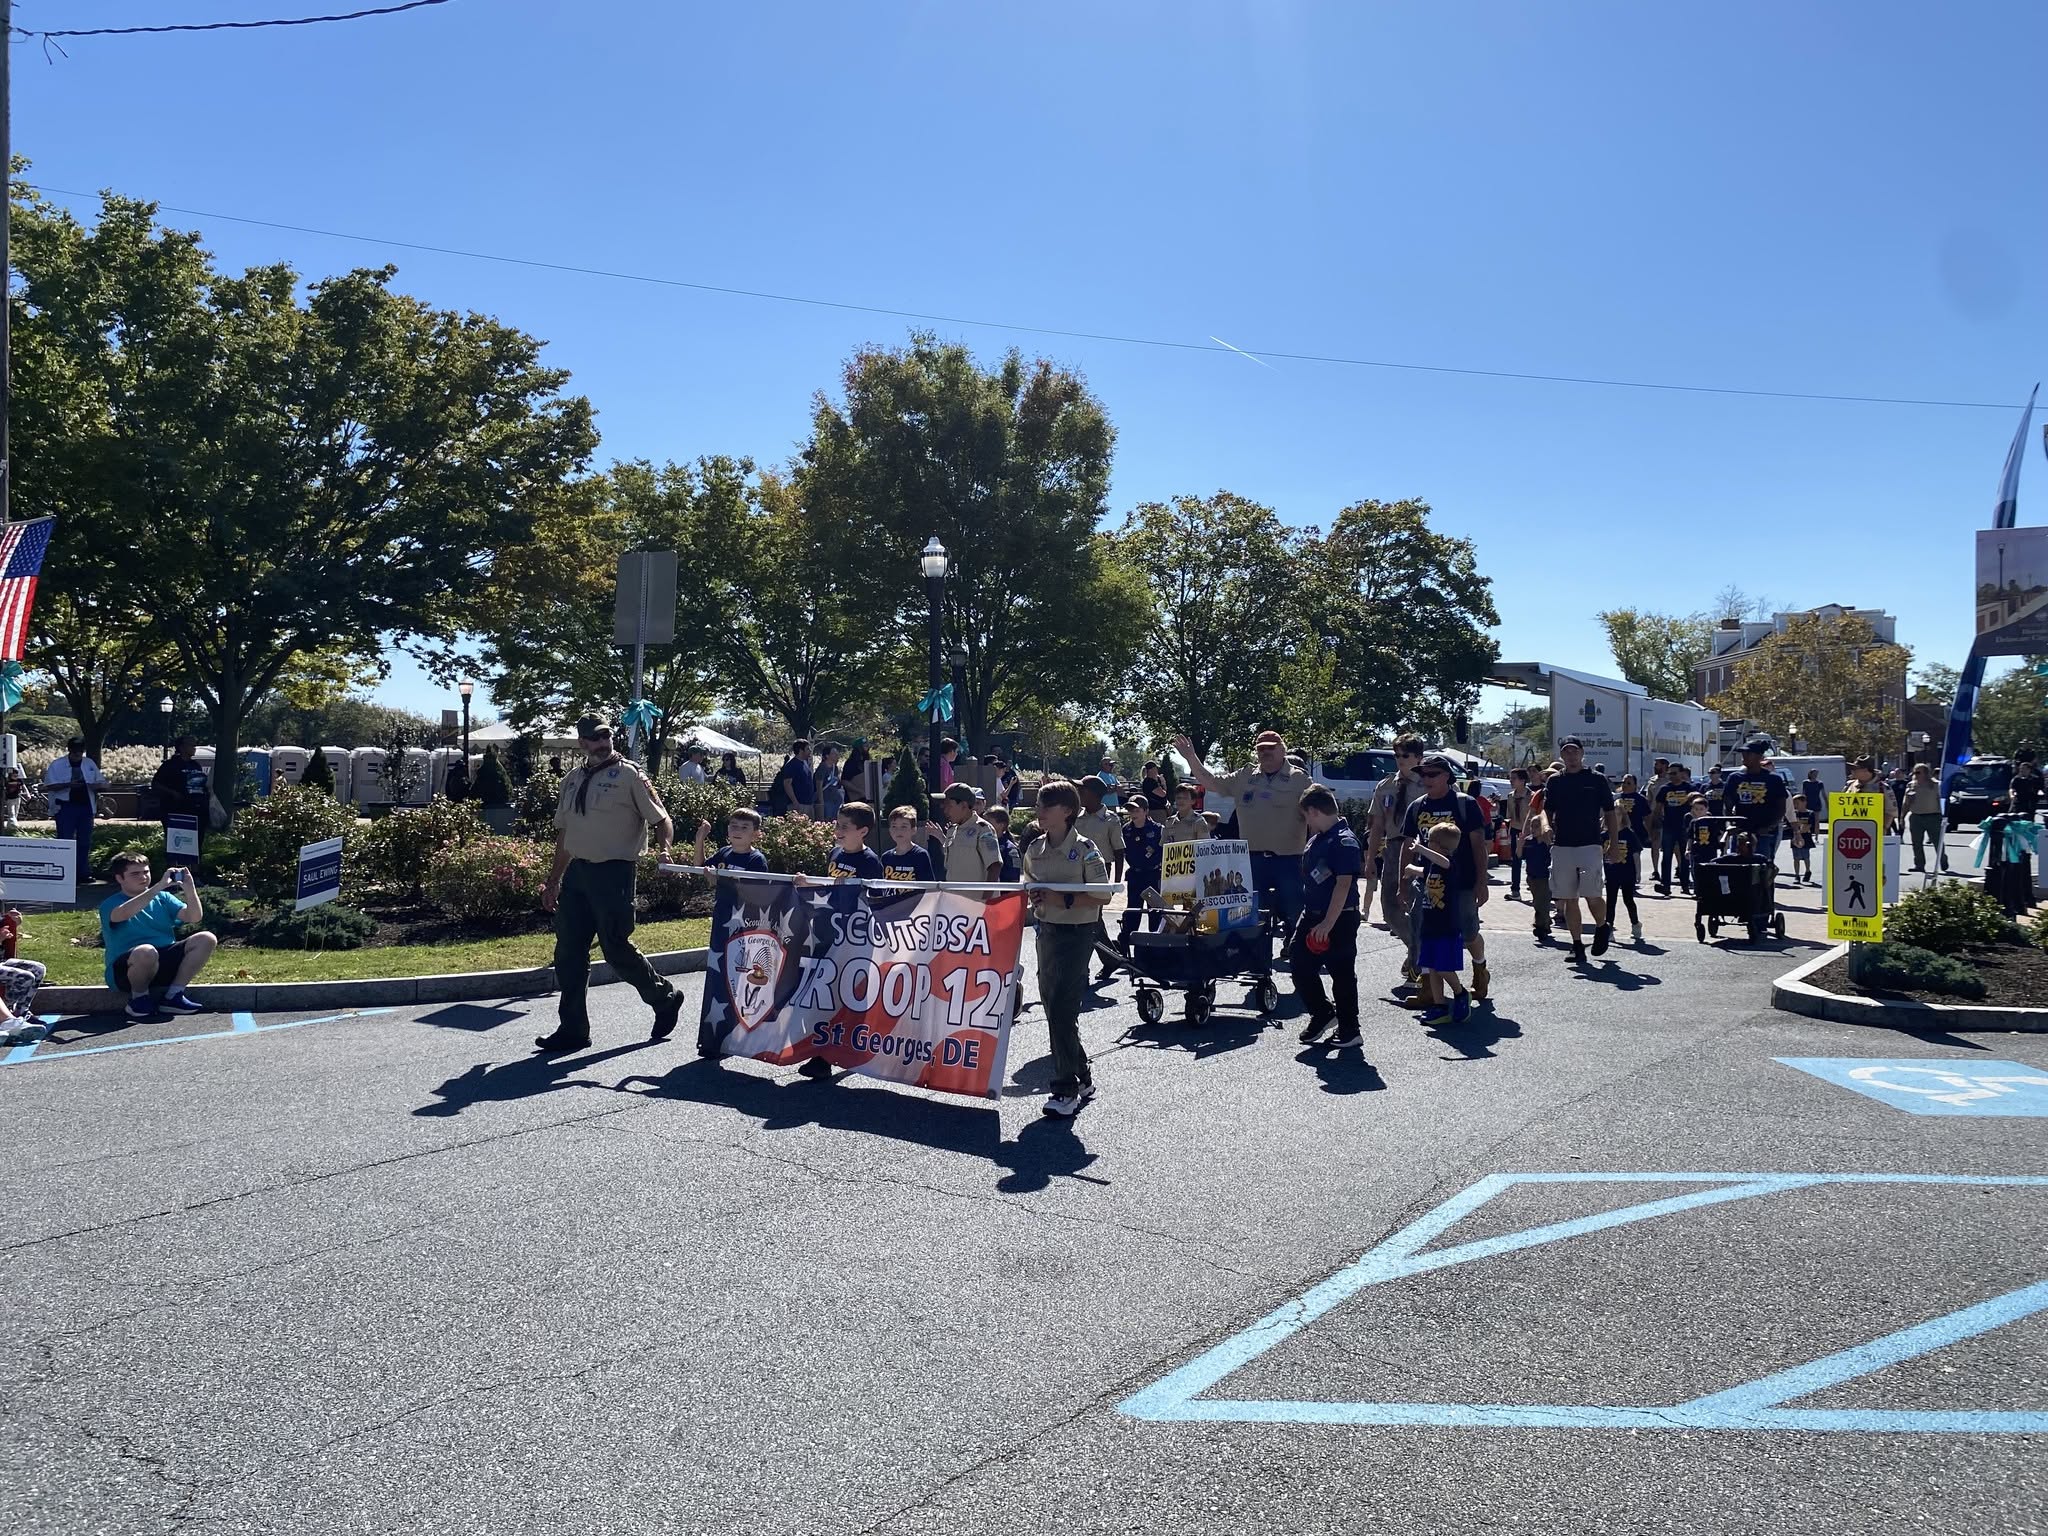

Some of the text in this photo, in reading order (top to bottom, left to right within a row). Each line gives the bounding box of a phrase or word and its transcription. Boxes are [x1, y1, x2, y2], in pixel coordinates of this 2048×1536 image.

[1838, 796, 1874, 806] STATE
[1843, 808, 1868, 817] LAW
[1195, 842, 1249, 857] Join Scouts Now!
[1839, 837, 1870, 850] STOP
[1166, 844, 1195, 861] JOIN CU
[3, 864, 63, 877] casella
[303, 865, 338, 884] SAUL EWING
[885, 865, 916, 881] Pack
[1165, 860, 1196, 878] SCOUTS
[1842, 919, 1868, 929] WITHIN
[830, 910, 931, 953] SCOUTS
[932, 914, 991, 956] BSA
[1833, 928, 1877, 938] CROSSWALK
[789, 955, 932, 1020] TROOP
[812, 1021, 981, 1069] St Georges, DE
